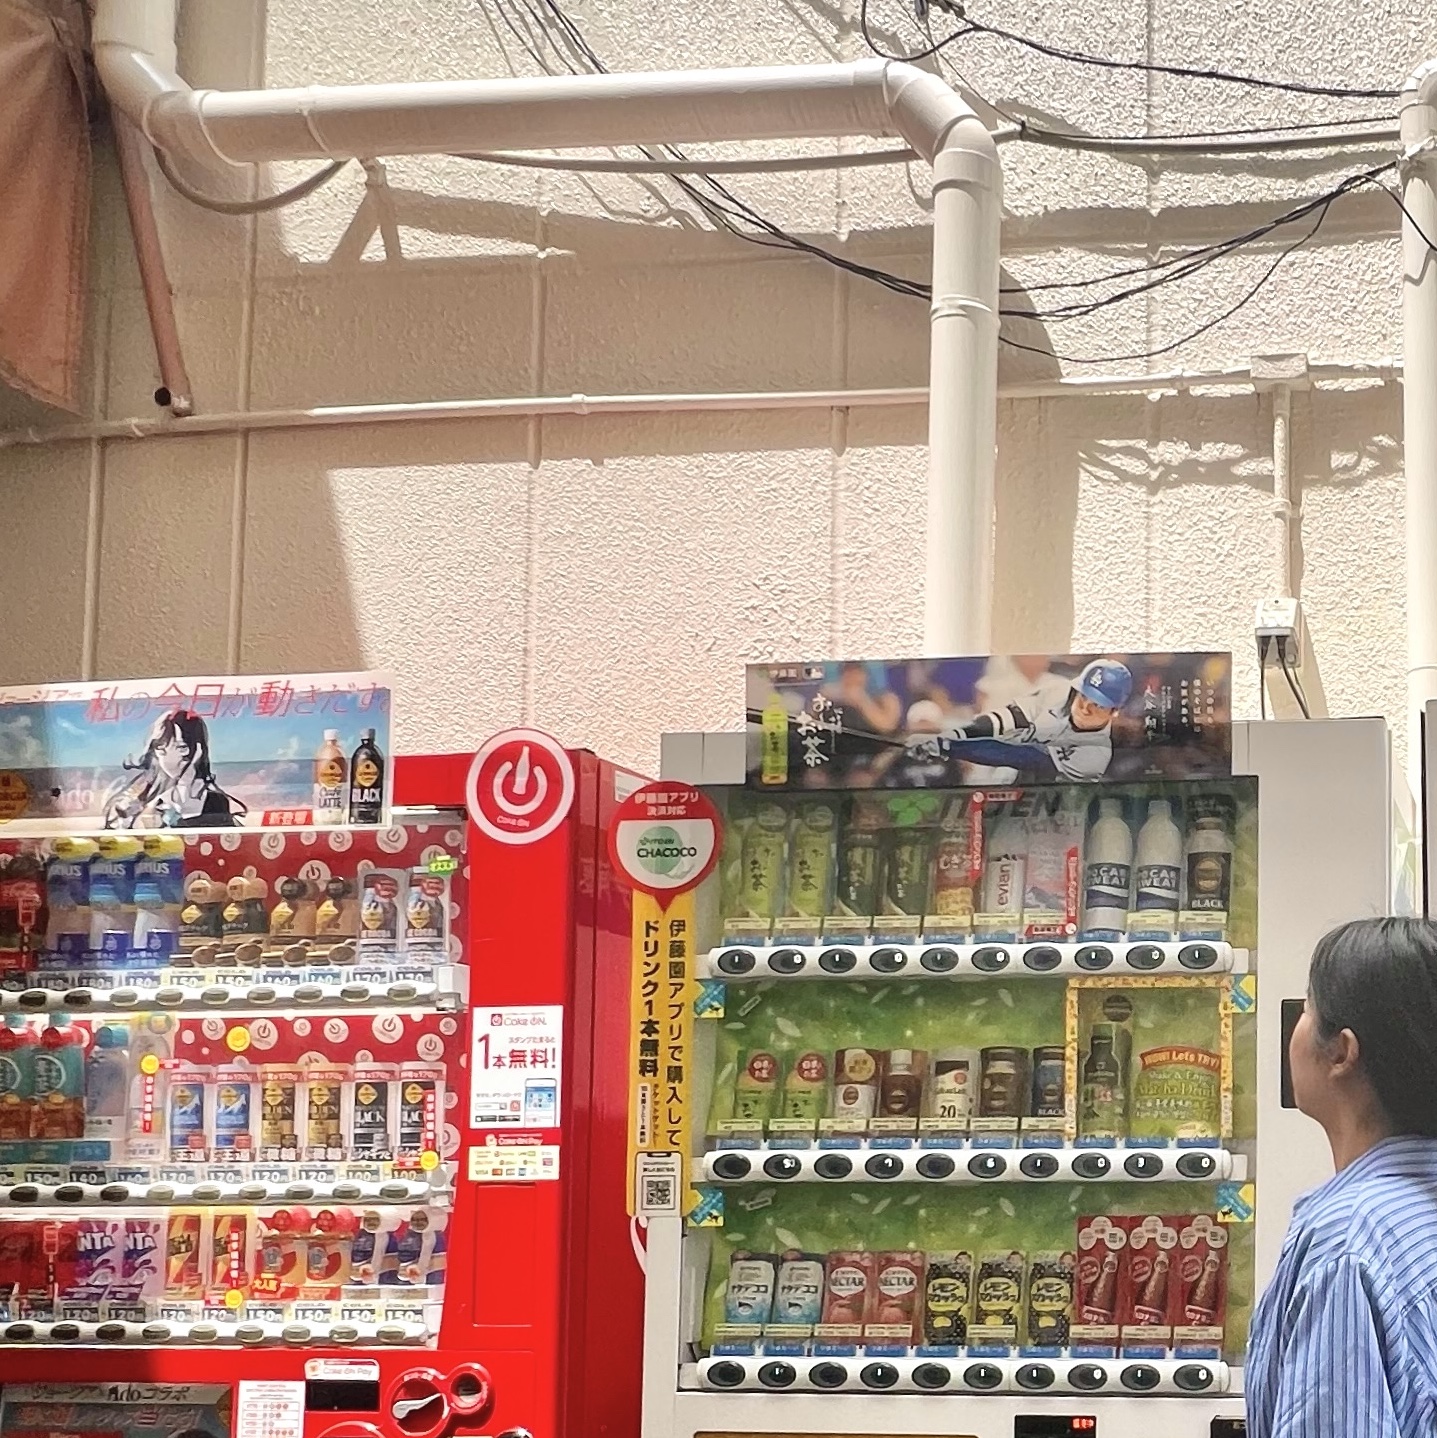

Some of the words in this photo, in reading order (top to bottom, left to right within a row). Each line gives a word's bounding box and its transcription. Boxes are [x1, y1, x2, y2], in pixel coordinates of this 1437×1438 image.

[352, 788, 382, 803] BLACK
[636, 846, 698, 858] CHACOCO
[996, 861, 1013, 907] evian
[1191, 899, 1223, 909] BLACK
[638, 919, 661, 1078] ドリンク1本無料
[477, 1033, 557, 1070] 1本無料!
[666, 918, 687, 1148] 伊藤園アプリで購入して
